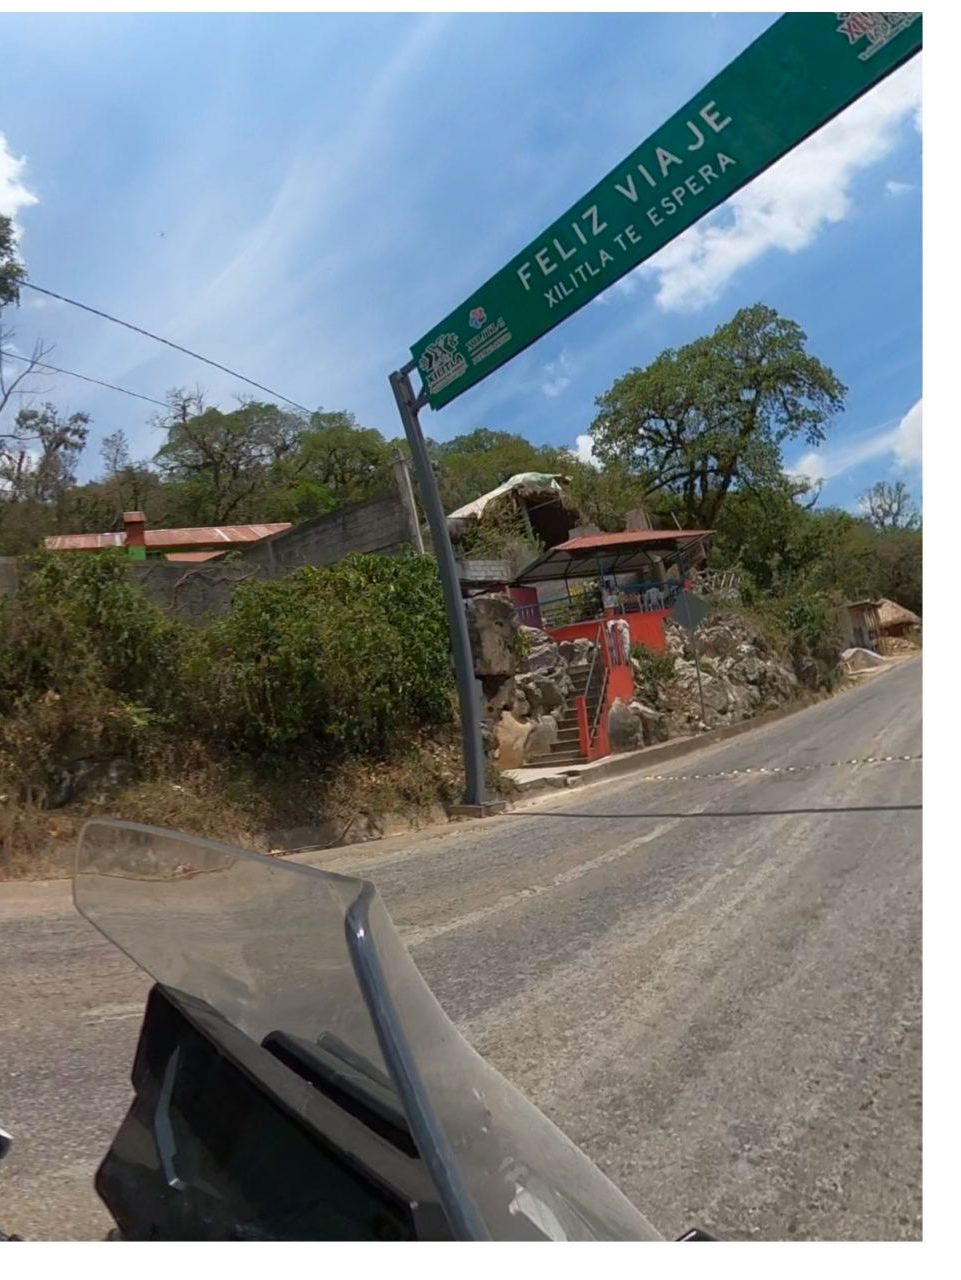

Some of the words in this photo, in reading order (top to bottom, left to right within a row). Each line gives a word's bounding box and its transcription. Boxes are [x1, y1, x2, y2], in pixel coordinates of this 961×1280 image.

[517, 205, 607, 290] FELIZ
[615, 101, 732, 203] VIAJE
[543, 249, 614, 308] XILITLA
[613, 224, 642, 251] TE
[646, 152, 737, 227] ESPERA
